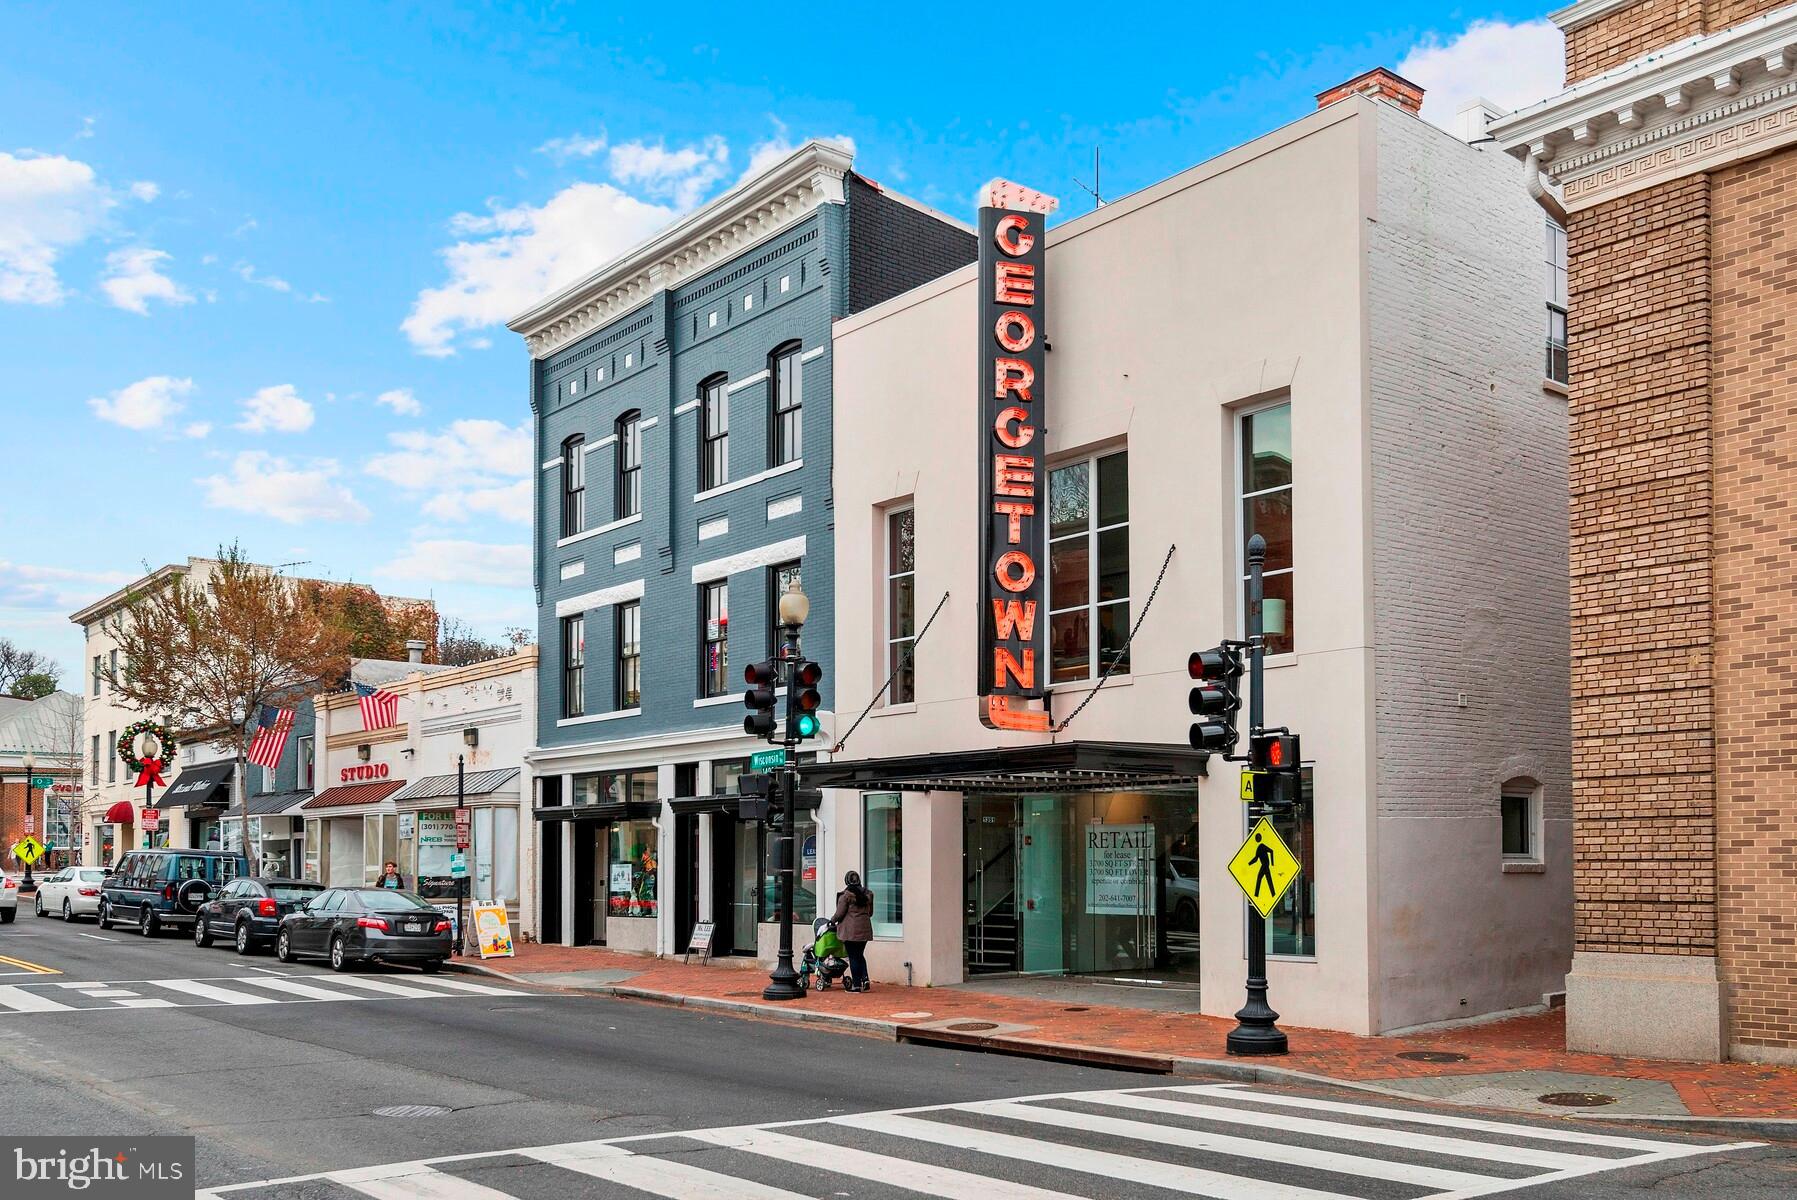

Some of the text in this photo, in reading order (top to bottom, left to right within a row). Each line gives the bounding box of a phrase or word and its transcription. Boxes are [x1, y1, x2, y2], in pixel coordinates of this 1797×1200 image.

[993, 213, 1035, 691] GEORGETOWN
[753, 753, 779, 766] Wisconsin
[341, 763, 389, 782] STUDIO
[422, 812, 442, 820] FOR
[421, 823, 439, 831] (301)
[1088, 831, 1153, 849] RETAIL
[1103, 850, 1131, 859] for lease
[1105, 860, 1114, 868] SQ
[1105, 869, 1114, 877] SQ
[422, 877, 455, 888] Signature
